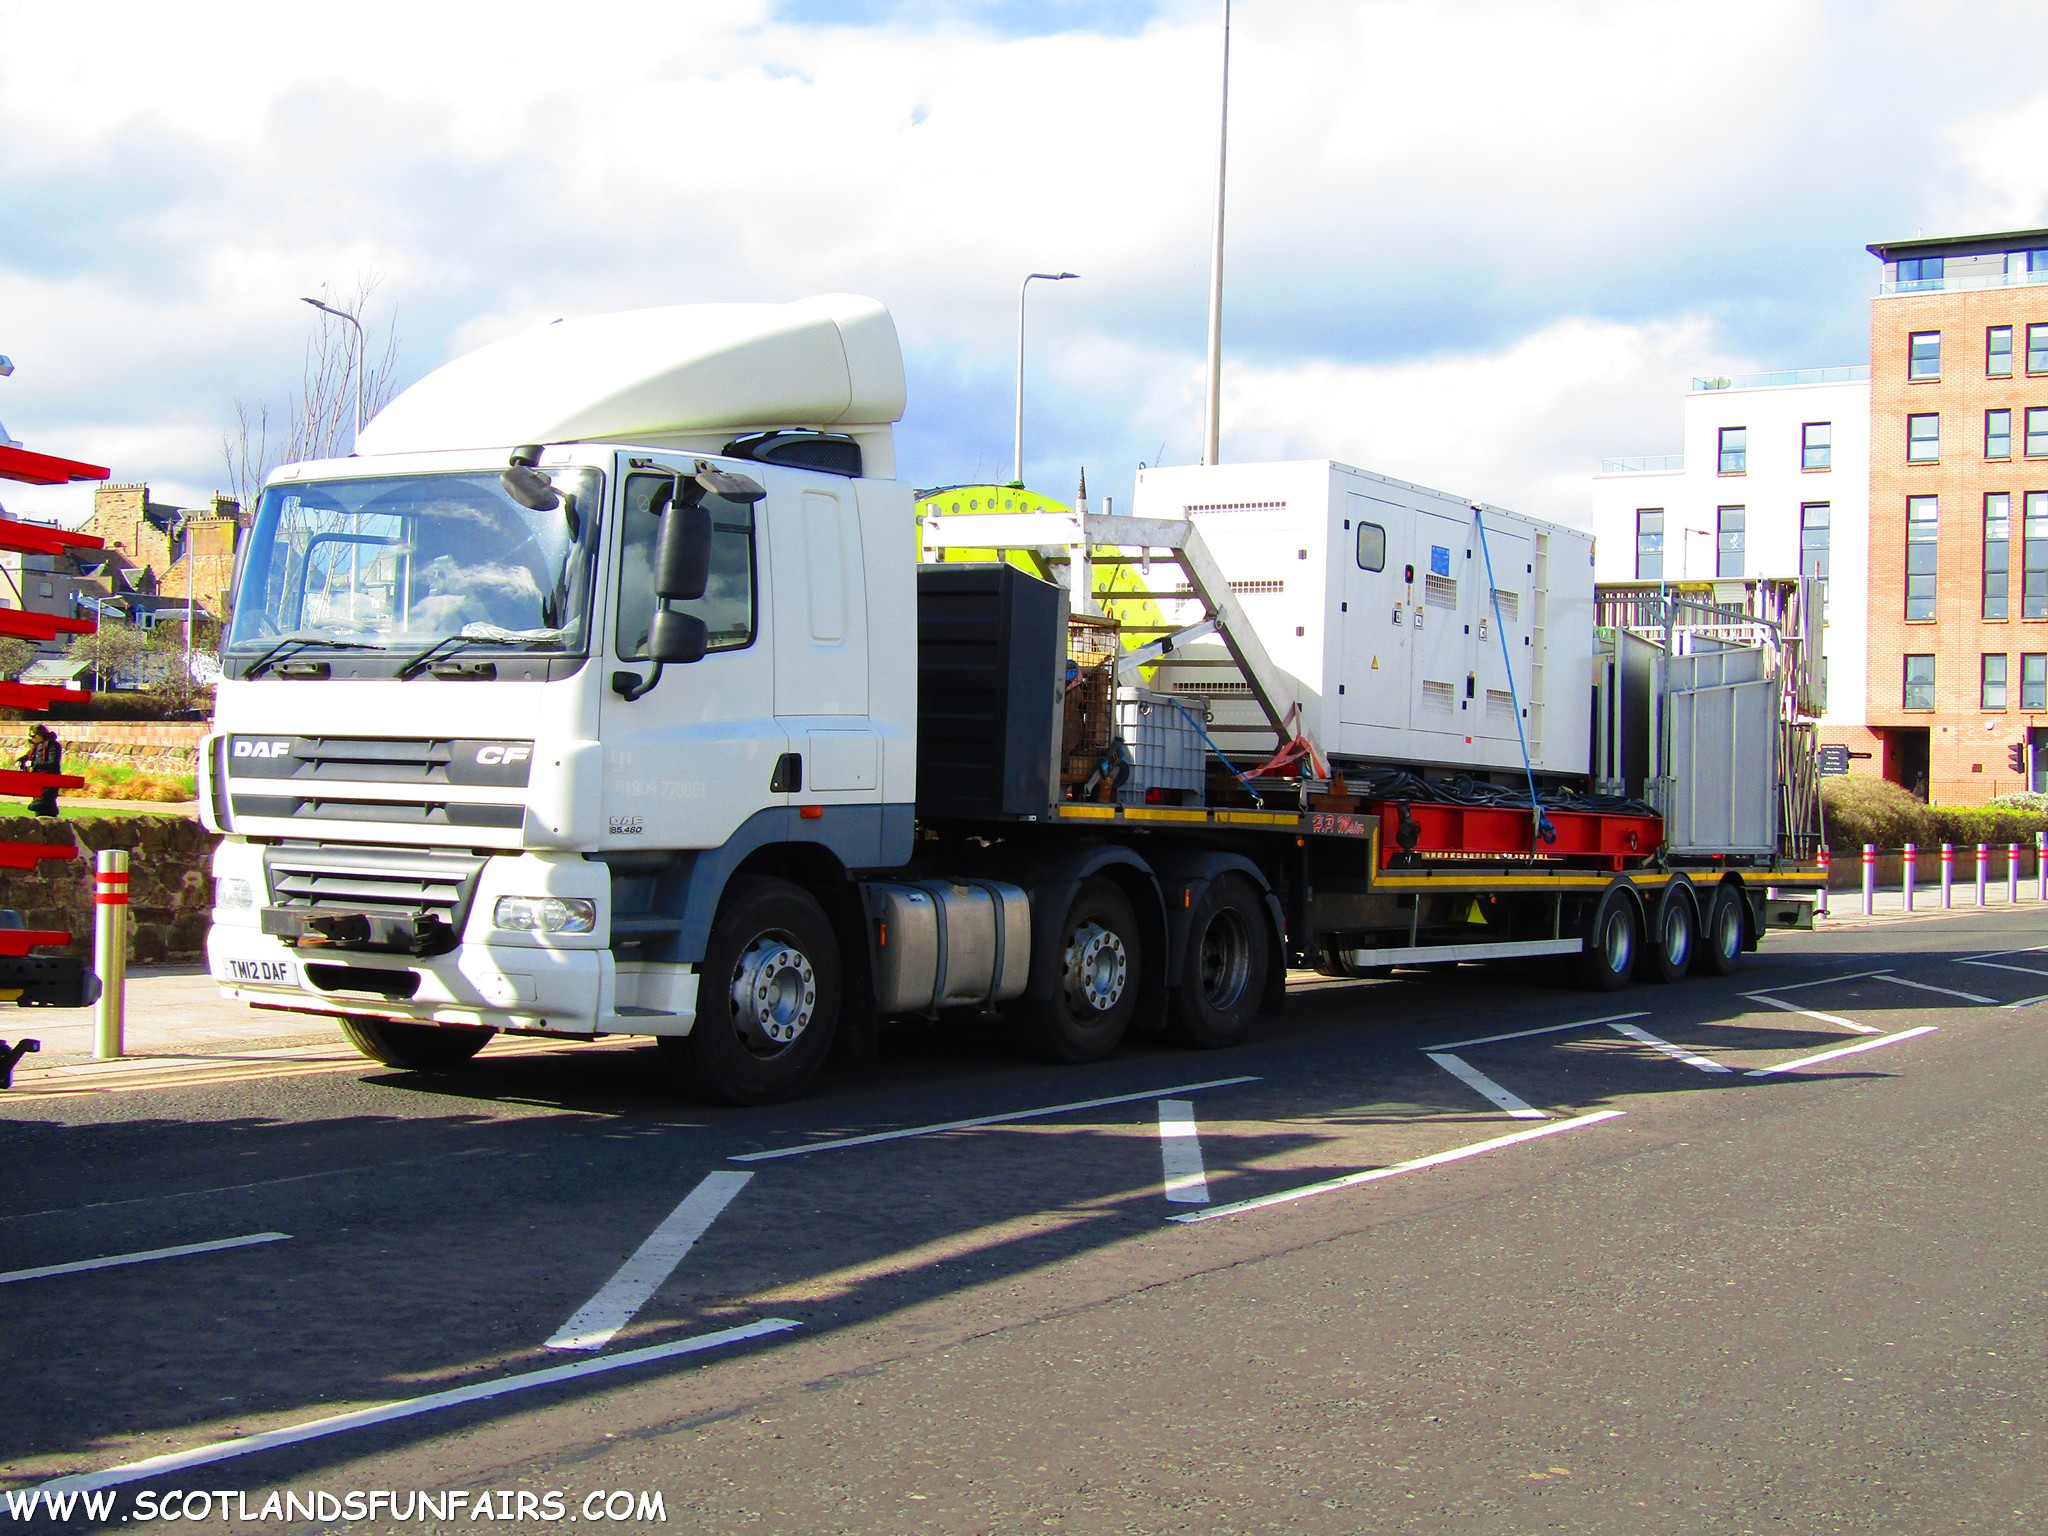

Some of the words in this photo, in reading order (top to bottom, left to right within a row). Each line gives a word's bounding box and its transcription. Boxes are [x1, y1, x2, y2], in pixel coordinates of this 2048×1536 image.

[233, 741, 291, 758] DAF
[476, 746, 531, 765] CF
[609, 816, 643, 825] DAF
[229, 960, 260, 980] TM12
[261, 962, 287, 981] DAF
